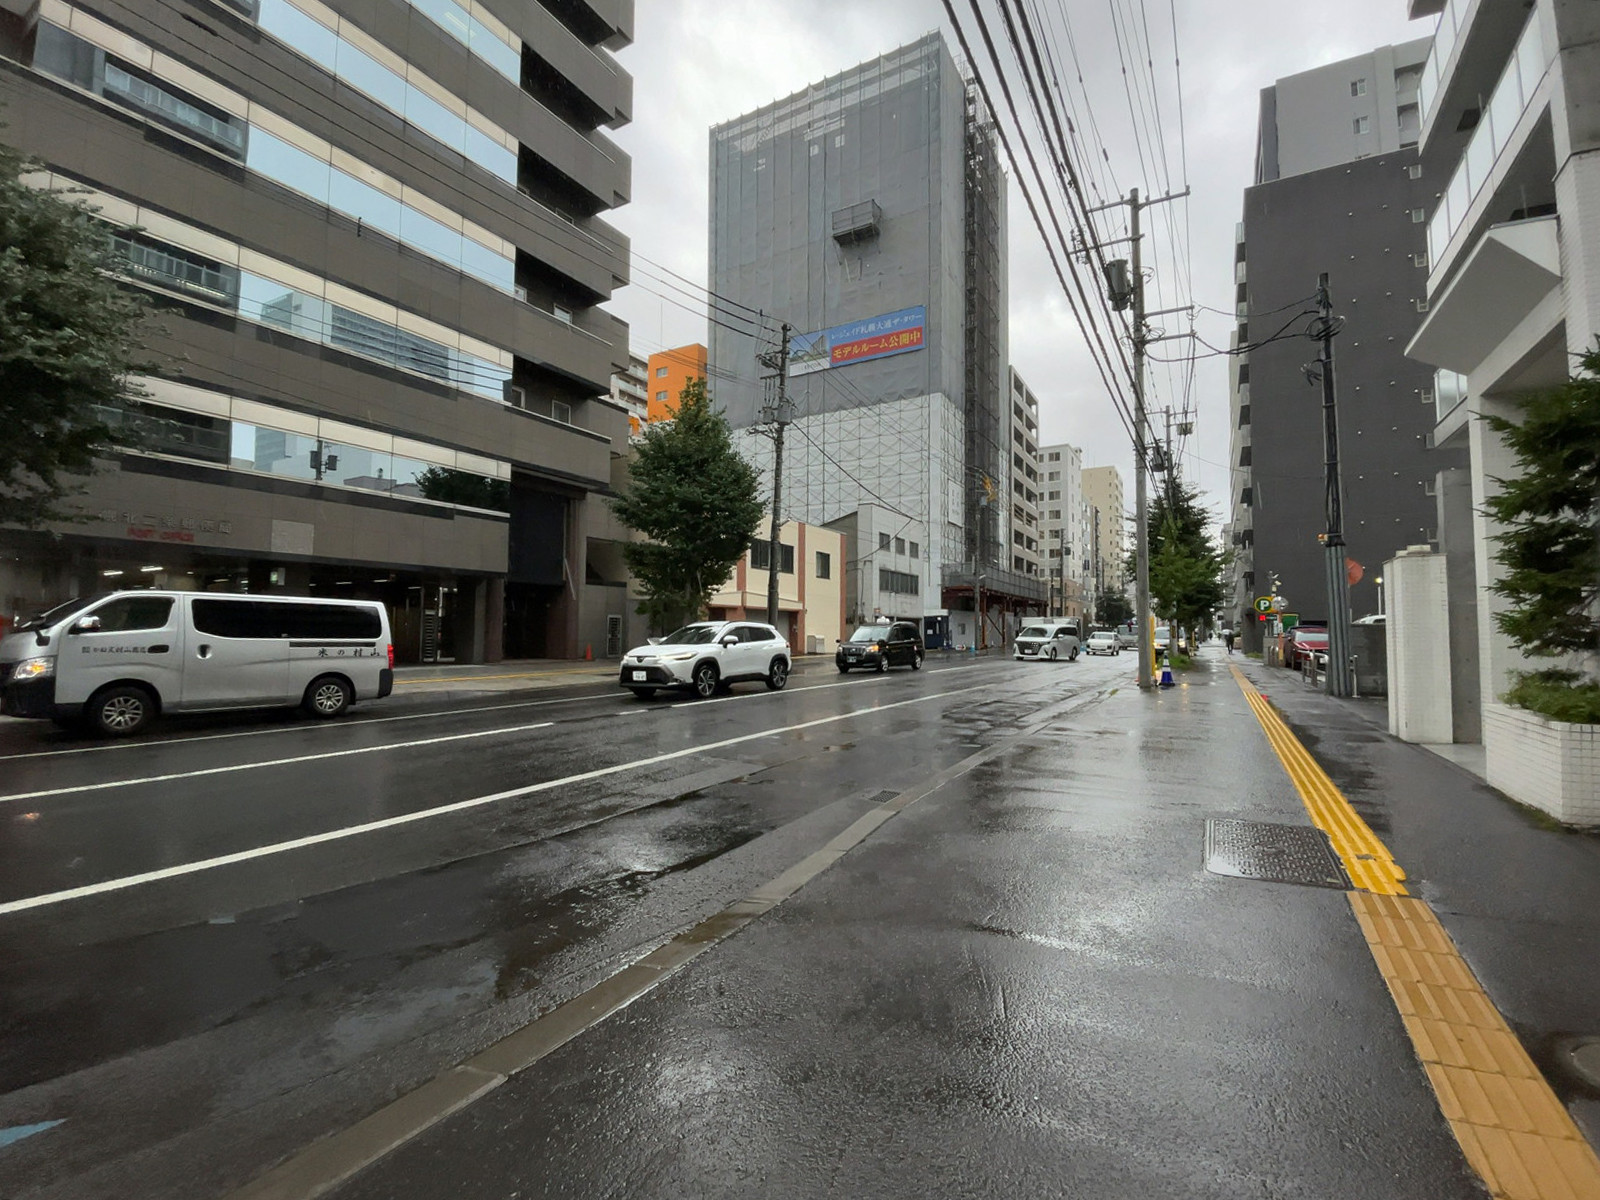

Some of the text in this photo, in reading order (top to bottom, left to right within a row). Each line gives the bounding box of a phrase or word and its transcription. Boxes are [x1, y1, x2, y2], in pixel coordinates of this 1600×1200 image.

[833, 330, 921, 359] モデルルーム公開中
[1260, 600, 1270, 611] P
